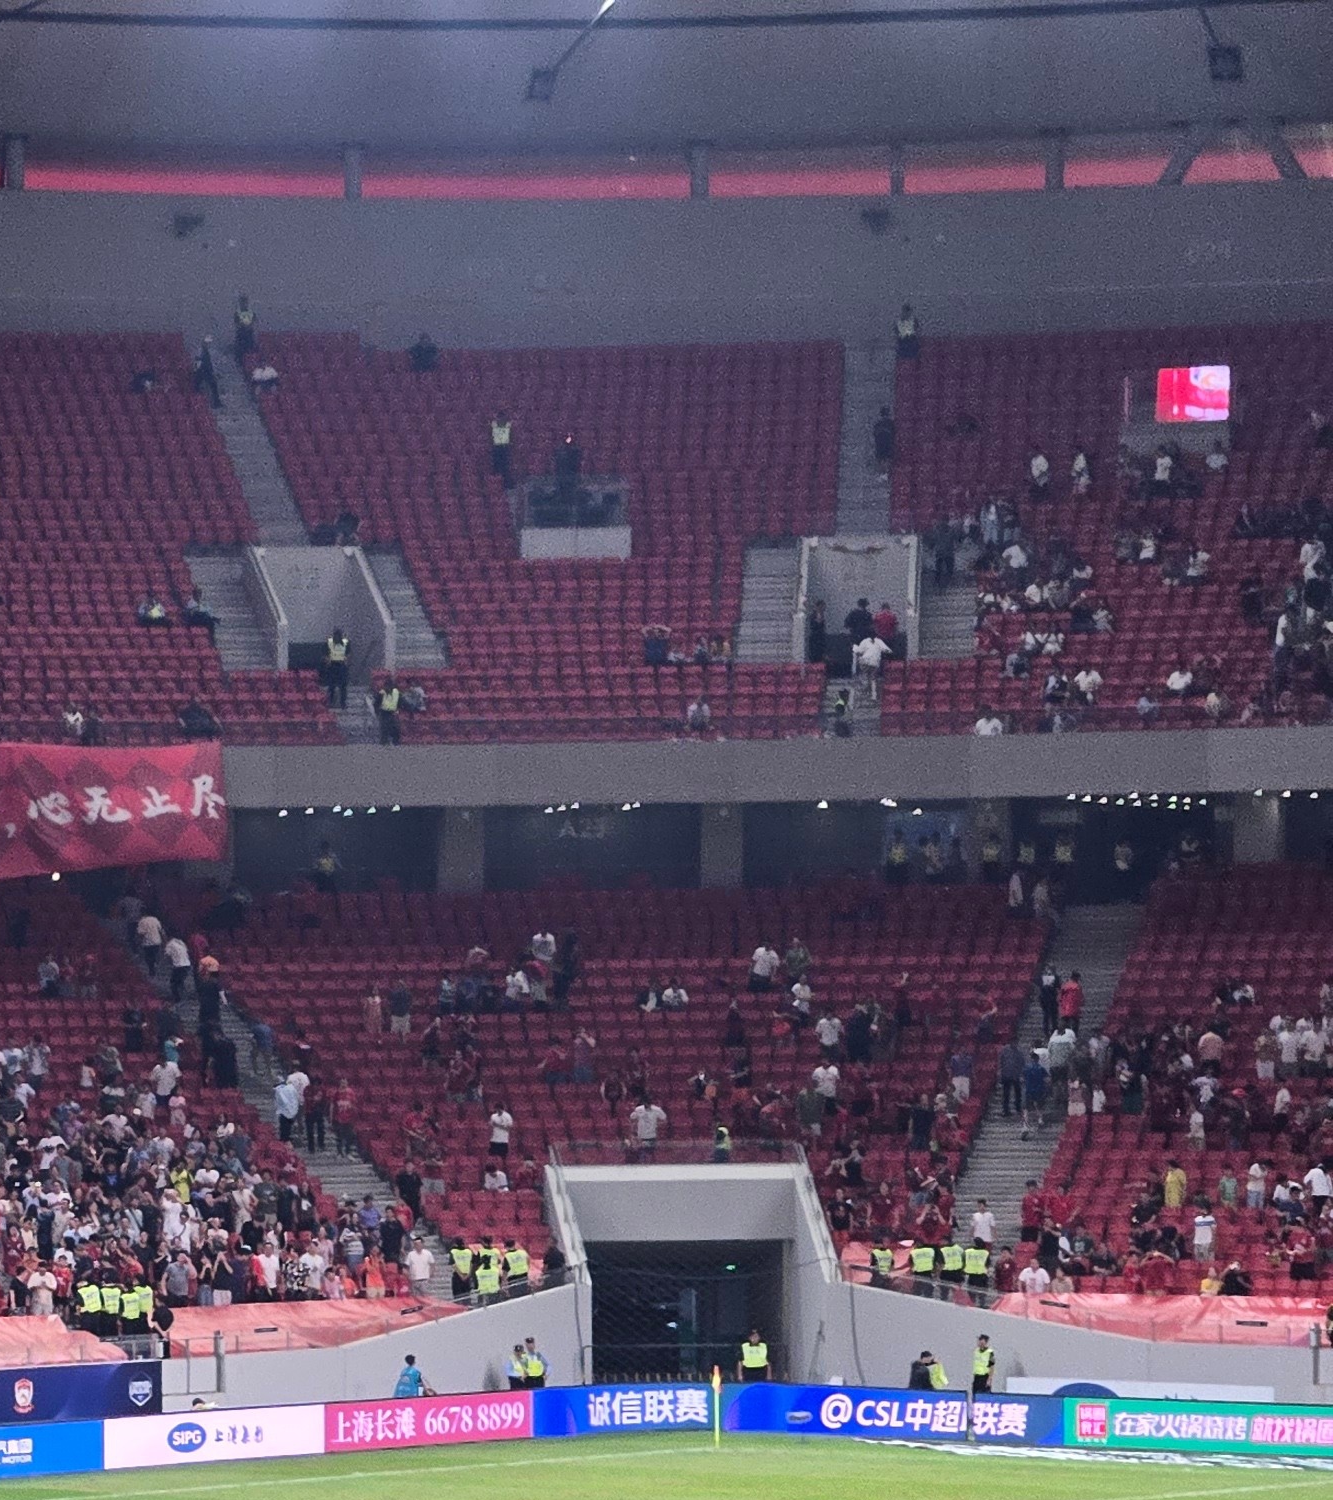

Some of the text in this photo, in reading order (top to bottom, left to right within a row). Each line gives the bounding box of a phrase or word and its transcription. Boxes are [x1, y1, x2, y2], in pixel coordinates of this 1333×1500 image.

[331, 1401, 525, 1444] 上海长滩 6678 8899
[587, 1388, 709, 1427] 诚信联赛
[172, 1430, 202, 1446] SIPG
